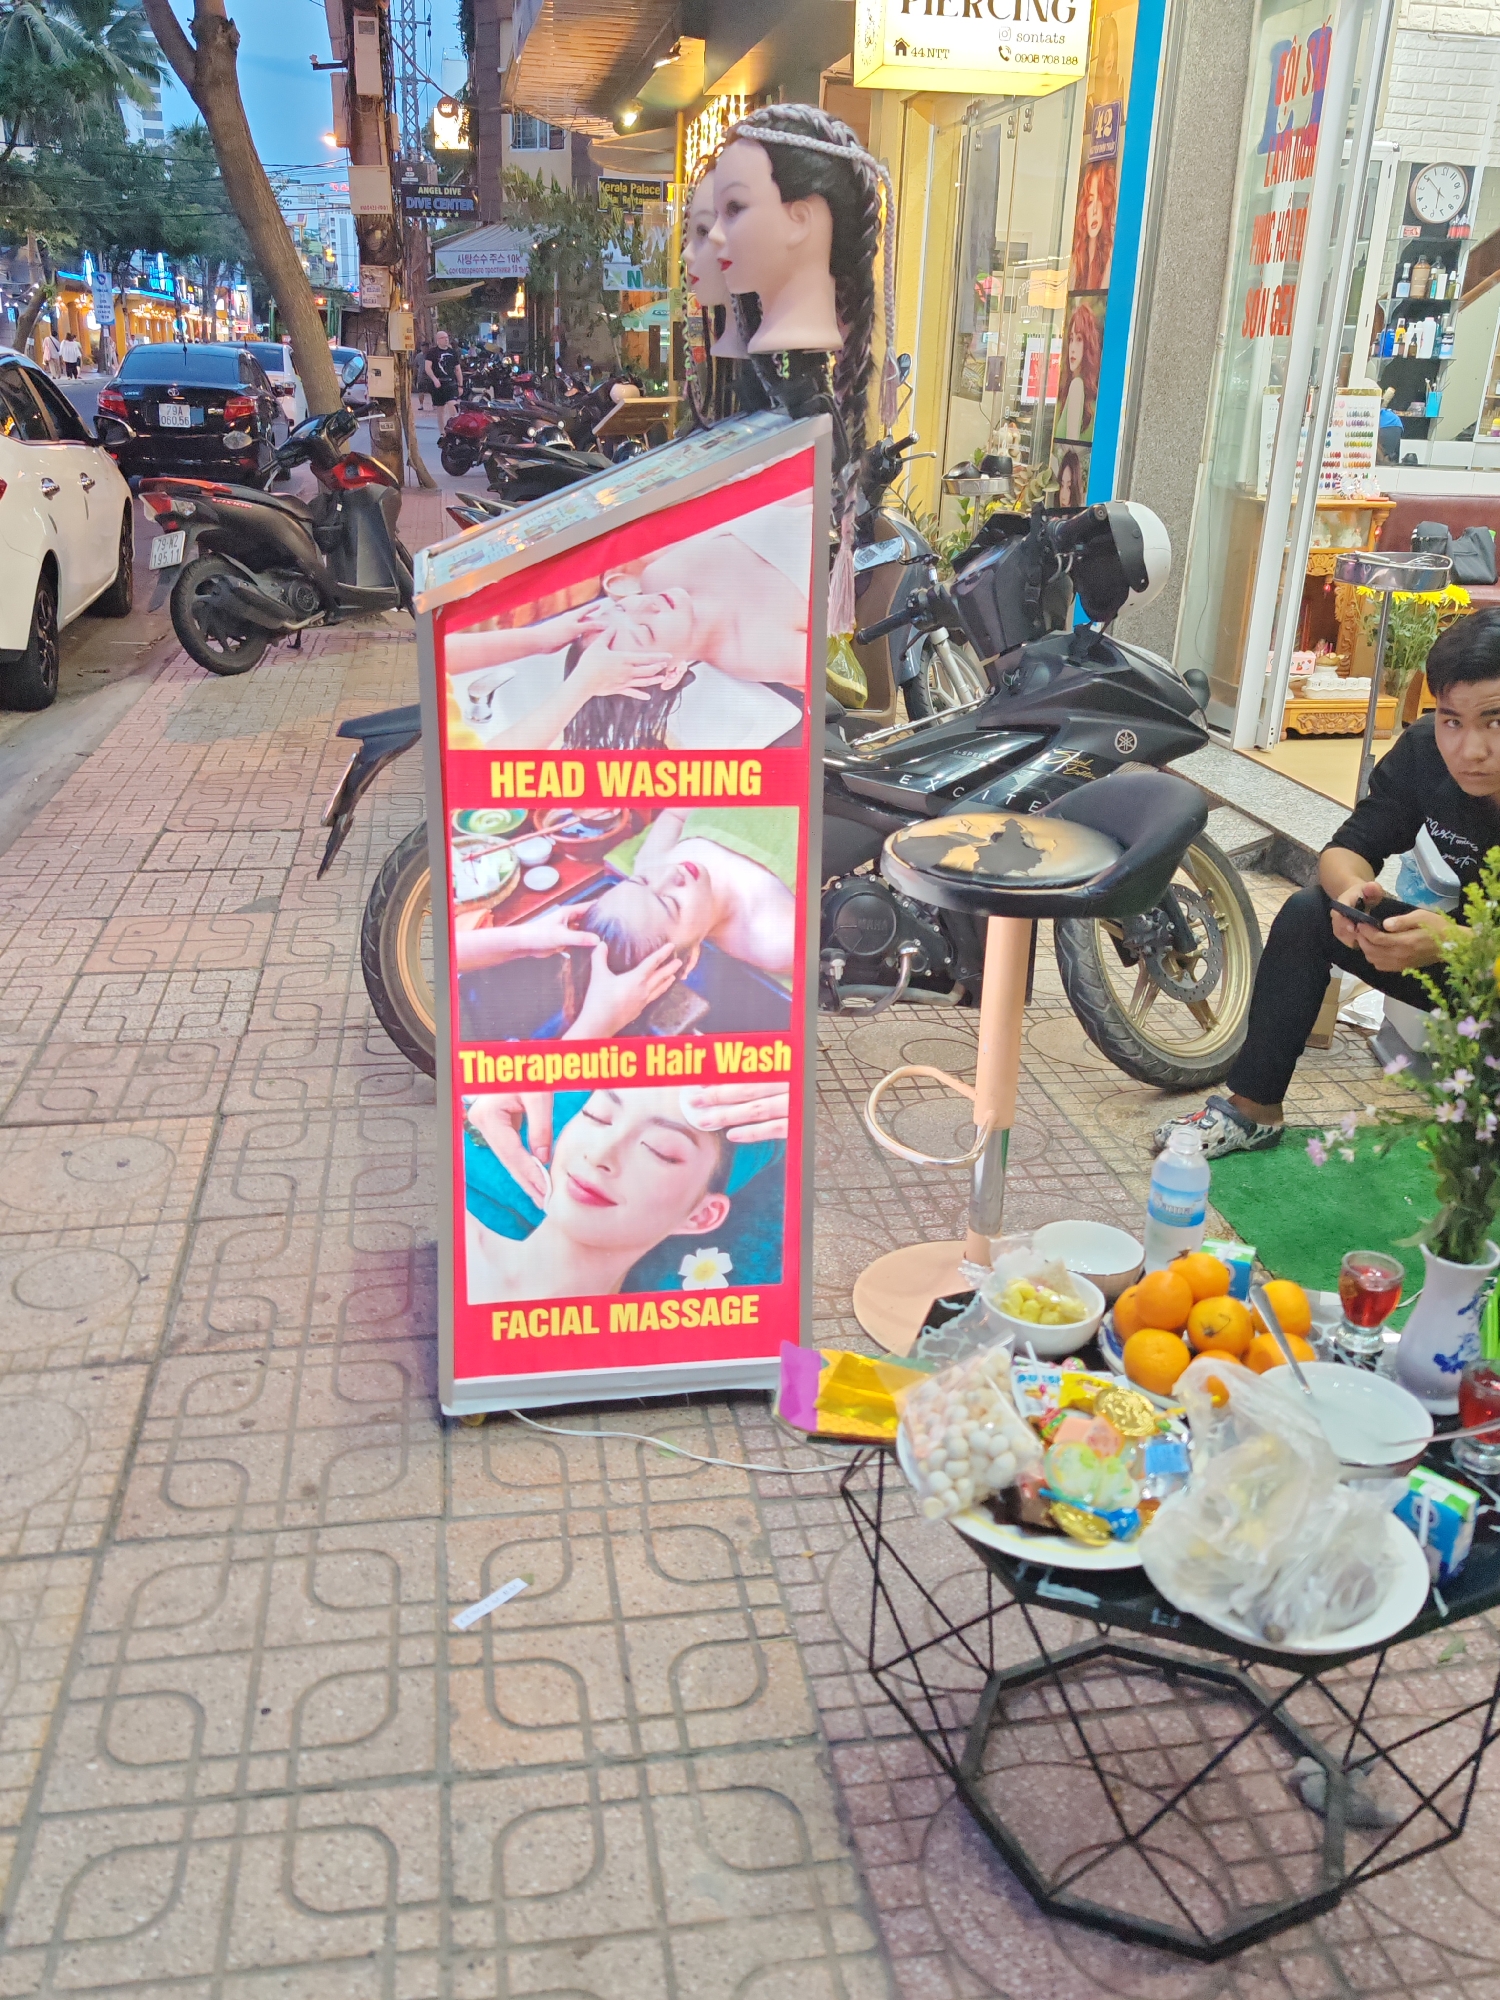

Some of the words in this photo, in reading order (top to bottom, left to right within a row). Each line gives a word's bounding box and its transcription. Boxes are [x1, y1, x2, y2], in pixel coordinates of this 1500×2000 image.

[1016, 31, 1066, 44] sontats
[911, 46, 926, 58] 44
[926, 47, 949, 60] NTT
[1042, 54, 1060, 65] 708
[1062, 55, 1078, 66] 188
[1095, 108, 1113, 139] 42
[418, 186, 443, 195] ANGEL
[444, 187, 462, 196] DIVE
[599, 180, 628, 193] Kerala
[631, 182, 661, 195] Palace
[406, 196, 432, 209] DIVE
[433, 198, 475, 211] CENTER
[457, 253, 488, 265] 사탕수수
[489, 253, 506, 264] 주스
[166, 405, 183, 416] 79A
[161, 416, 190, 427] 060.56
[152, 549, 180, 568] 195.11
[490, 761, 585, 799] HEAD
[597, 759, 762, 798] WASHING
[459, 1046, 637, 1084] Therapeutic
[645, 1042, 706, 1076] Hair
[714, 1040, 792, 1074] Wash
[491, 1305, 600, 1341] FACIAL
[609, 1294, 760, 1334] MASSAGE
